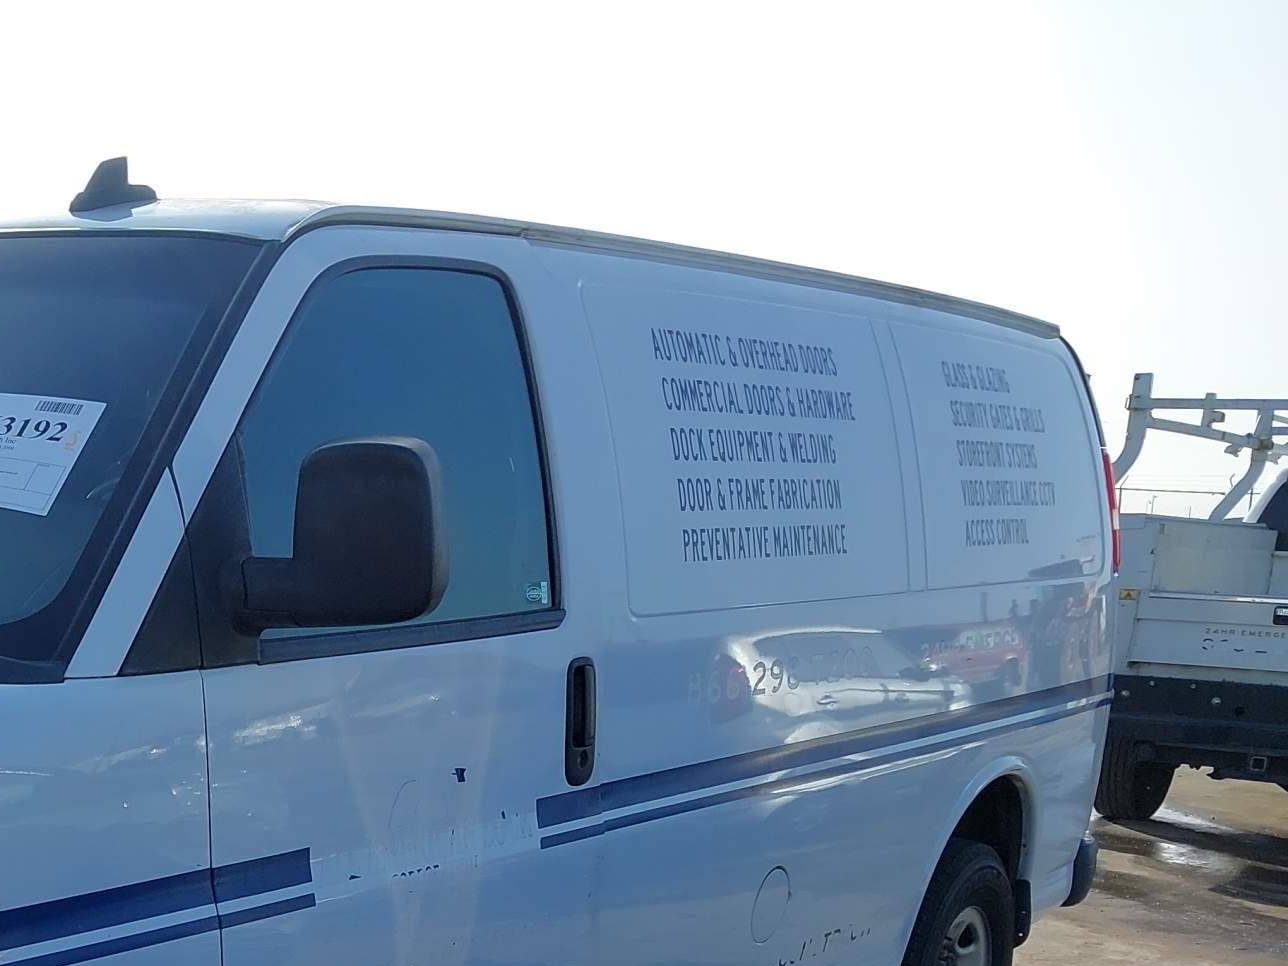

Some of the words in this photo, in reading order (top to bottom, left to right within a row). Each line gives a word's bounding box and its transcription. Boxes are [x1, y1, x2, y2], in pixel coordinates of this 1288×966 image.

[650, 327, 726, 366] AUTOMATIC
[726, 336, 738, 367] &
[738, 337, 799, 373] OVERHEAD
[798, 344, 838, 377] DOORS
[662, 377, 744, 414] COMMERCIAL
[744, 383, 785, 416] DOORS
[786, 387, 796, 417] &
[796, 388, 856, 421] HARDWARE
[670, 427, 708, 462] DOCK
[708, 428, 775, 463] EQUIPMENT
[778, 432, 788, 463] &
[788, 432, 837, 464] WELDING
[677, 478, 713, 511] DOOR
[716, 478, 727, 511] &
[728, 478, 768, 510] FRAME
[769, 478, 842, 510] FABRICATION
[683, 526, 771, 562] PREVENTATIVE
[772, 524, 848, 558] MAINTENANCE
[965, 519, 997, 547] ACCESS
